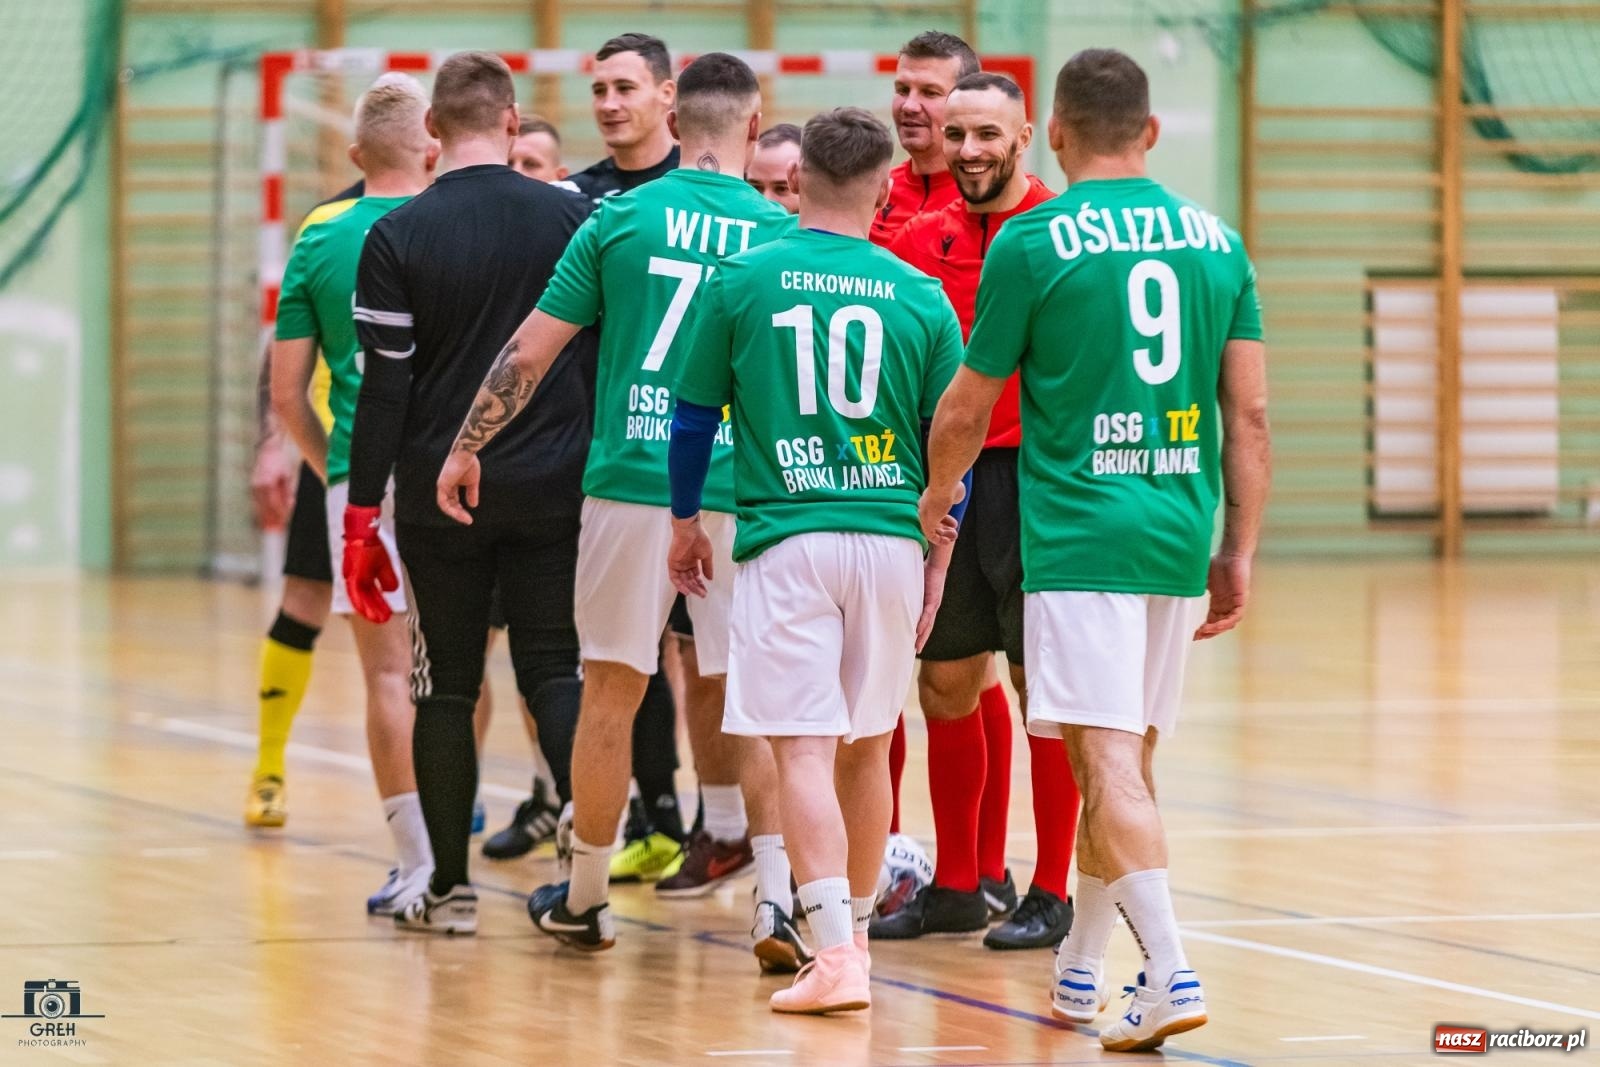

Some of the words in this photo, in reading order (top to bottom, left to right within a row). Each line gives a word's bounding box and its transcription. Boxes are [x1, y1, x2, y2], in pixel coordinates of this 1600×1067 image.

[665, 207, 757, 256] WITT
[781, 270, 896, 301] CERKOWNIAK
[641, 255, 715, 372] 7
[1127, 258, 1182, 385] 9
[771, 304, 884, 420] 10
[629, 383, 670, 415] OSG
[1093, 411, 1144, 444] OSG
[776, 435, 825, 468] OSG
[850, 428, 896, 464] TBŹ
[1092, 448, 1150, 476] BRUKI
[782, 466, 836, 494] BRUKI
[841, 462, 905, 491] JANACZ
